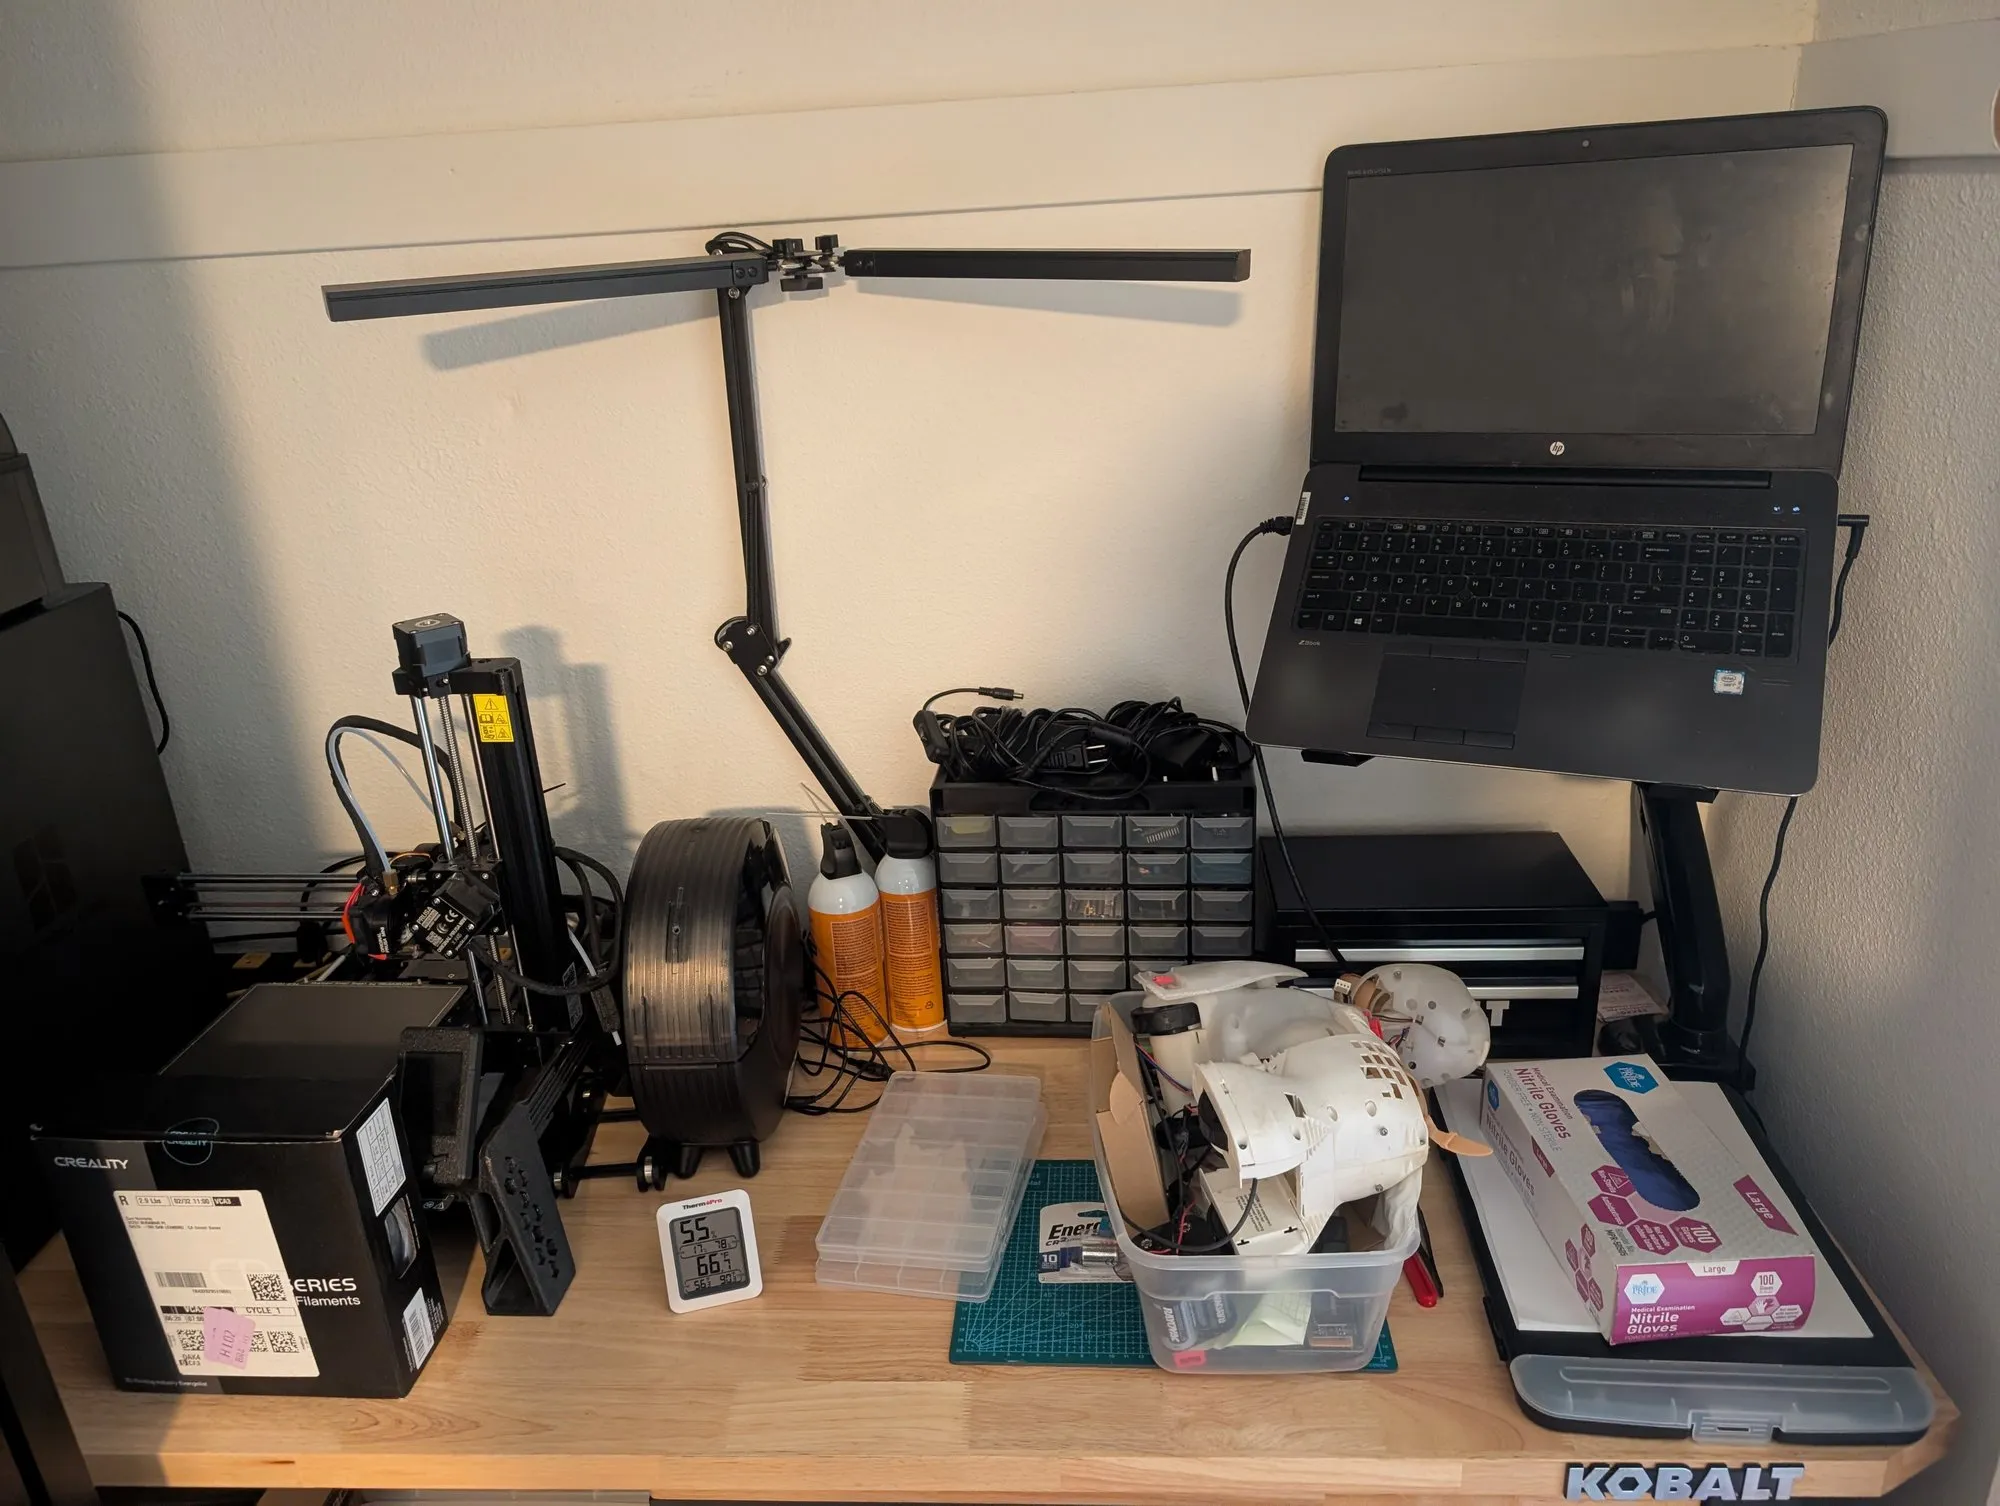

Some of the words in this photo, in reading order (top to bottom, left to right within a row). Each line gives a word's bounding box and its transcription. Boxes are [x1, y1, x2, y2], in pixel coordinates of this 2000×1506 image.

[1551, 441, 1564, 455] hp
[1514, 1068, 1544, 1101] Nitrile
[1539, 1102, 1571, 1139] Gloves
[1546, 1086, 1574, 1120] Examination
[1486, 1113, 1508, 1156] Nitrile
[1510, 1150, 1535, 1196] Gloves
[54, 1156, 128, 1169] CREALITY
[119, 1195, 129, 1206] R
[682, 1198, 723, 1210] ThermoPro
[1746, 1191, 1773, 1221] Large
[680, 1217, 709, 1244] 55
[1690, 1224, 1717, 1244] 100
[1042, 1254, 1058, 1262] 10
[1703, 1264, 1727, 1275] Large
[290, 1278, 357, 1292] ERIES
[1759, 1274, 1774, 1286] 100
[295, 1296, 361, 1306] Filaments
[246, 1306, 272, 1314] CYCLE
[1656, 1305, 1695, 1313] Examination
[1629, 1312, 1679, 1324] Nitrile
[1627, 1324, 1678, 1334] Gloves
[1564, 1463, 1805, 1500] KOBALT
